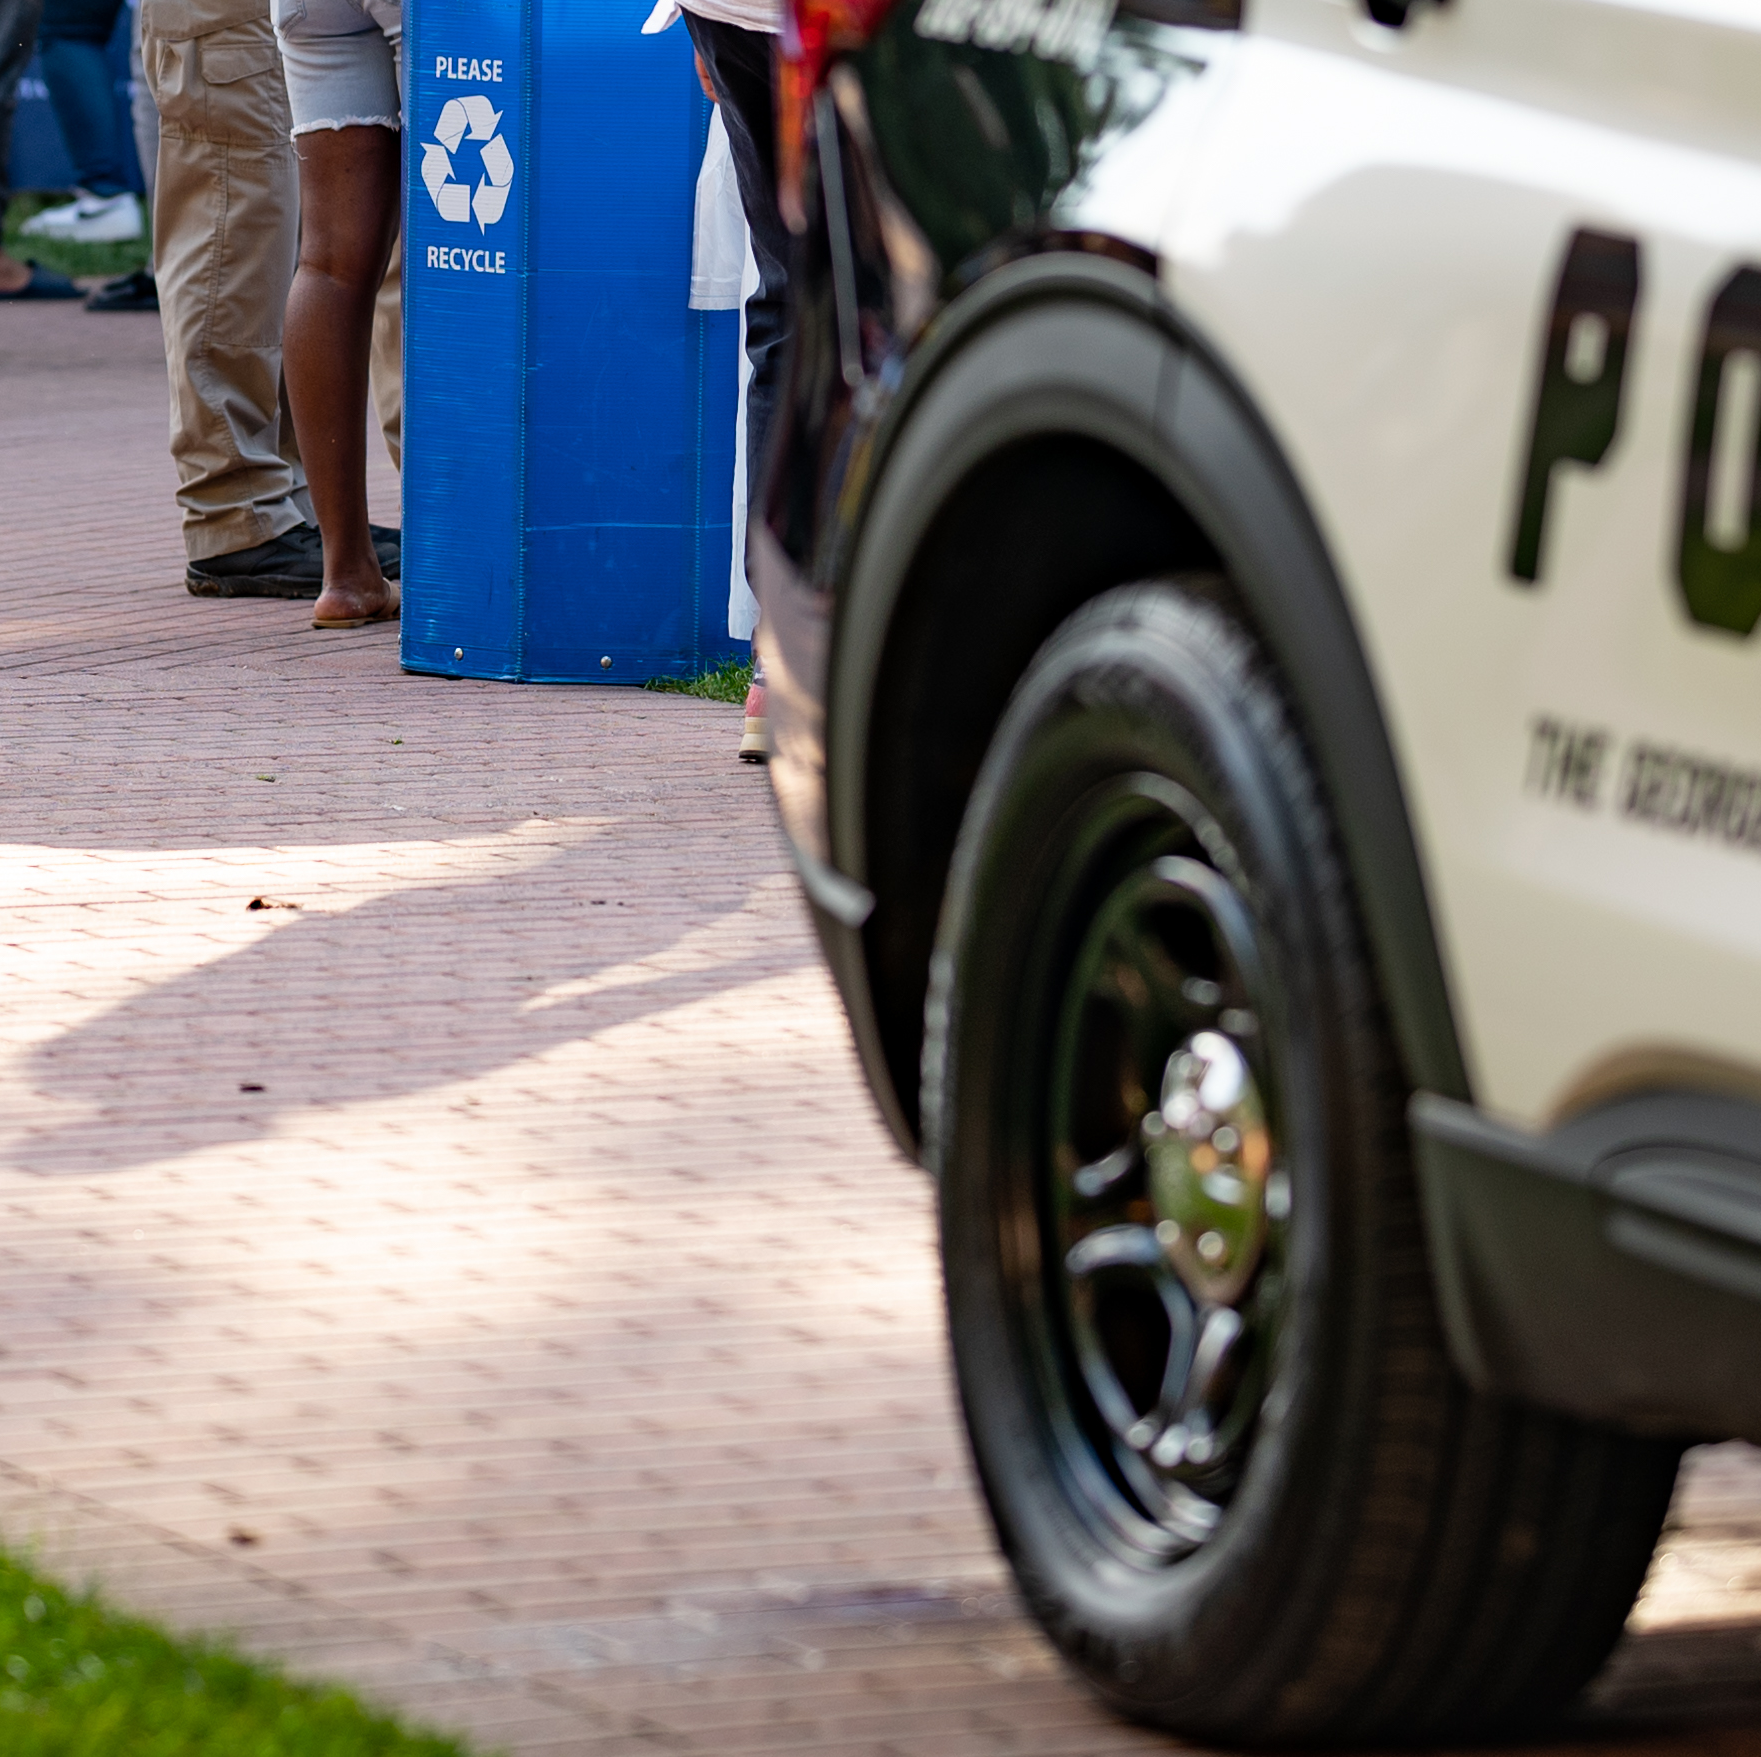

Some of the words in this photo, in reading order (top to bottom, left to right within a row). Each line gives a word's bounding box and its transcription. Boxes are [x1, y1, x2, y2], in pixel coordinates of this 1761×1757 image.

[435, 56, 503, 82] PLEASE
[427, 245, 506, 274] RECYCLE
[1526, 715, 1609, 811] THE
